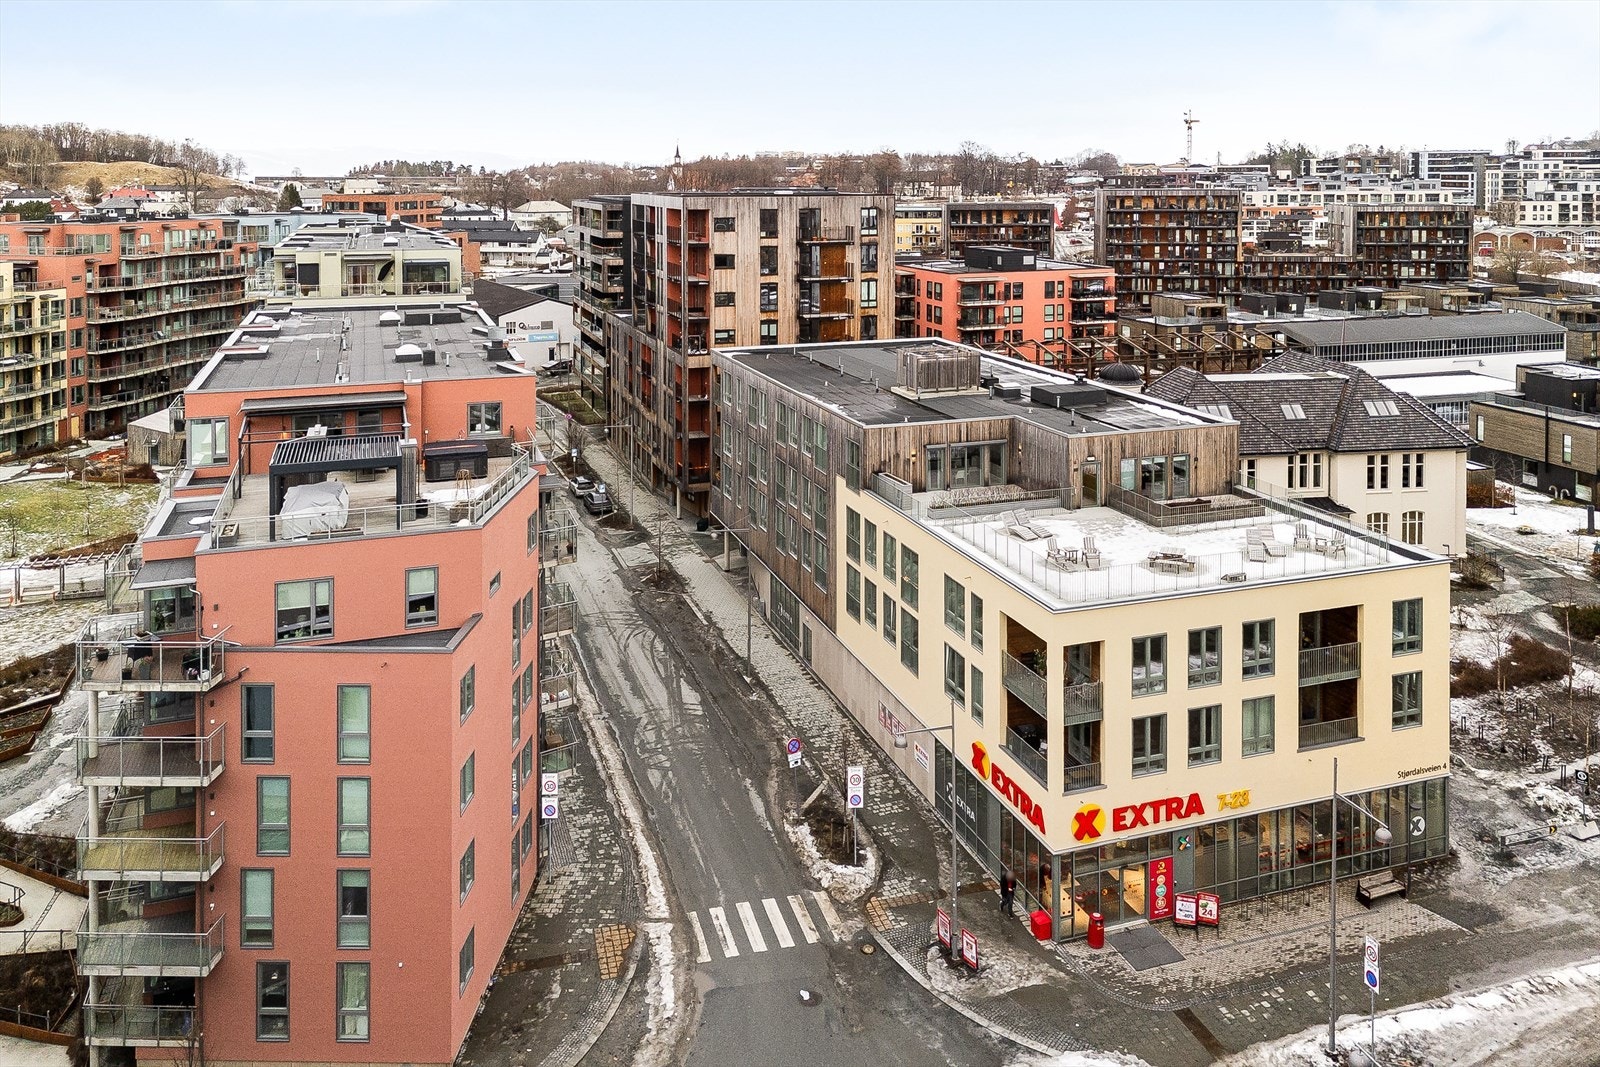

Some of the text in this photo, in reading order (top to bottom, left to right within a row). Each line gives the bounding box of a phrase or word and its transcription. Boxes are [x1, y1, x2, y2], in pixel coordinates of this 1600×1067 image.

[1397, 764, 1442, 779] Stjørdalsveien
[956, 794, 976, 823] EXTRA
[991, 762, 1046, 835] EXTRA
[1112, 792, 1205, 832] EXTRA
[1217, 789, 1251, 811] 7-23
[1202, 908, 1213, 917] 24
[1369, 948, 1375, 959] 30
